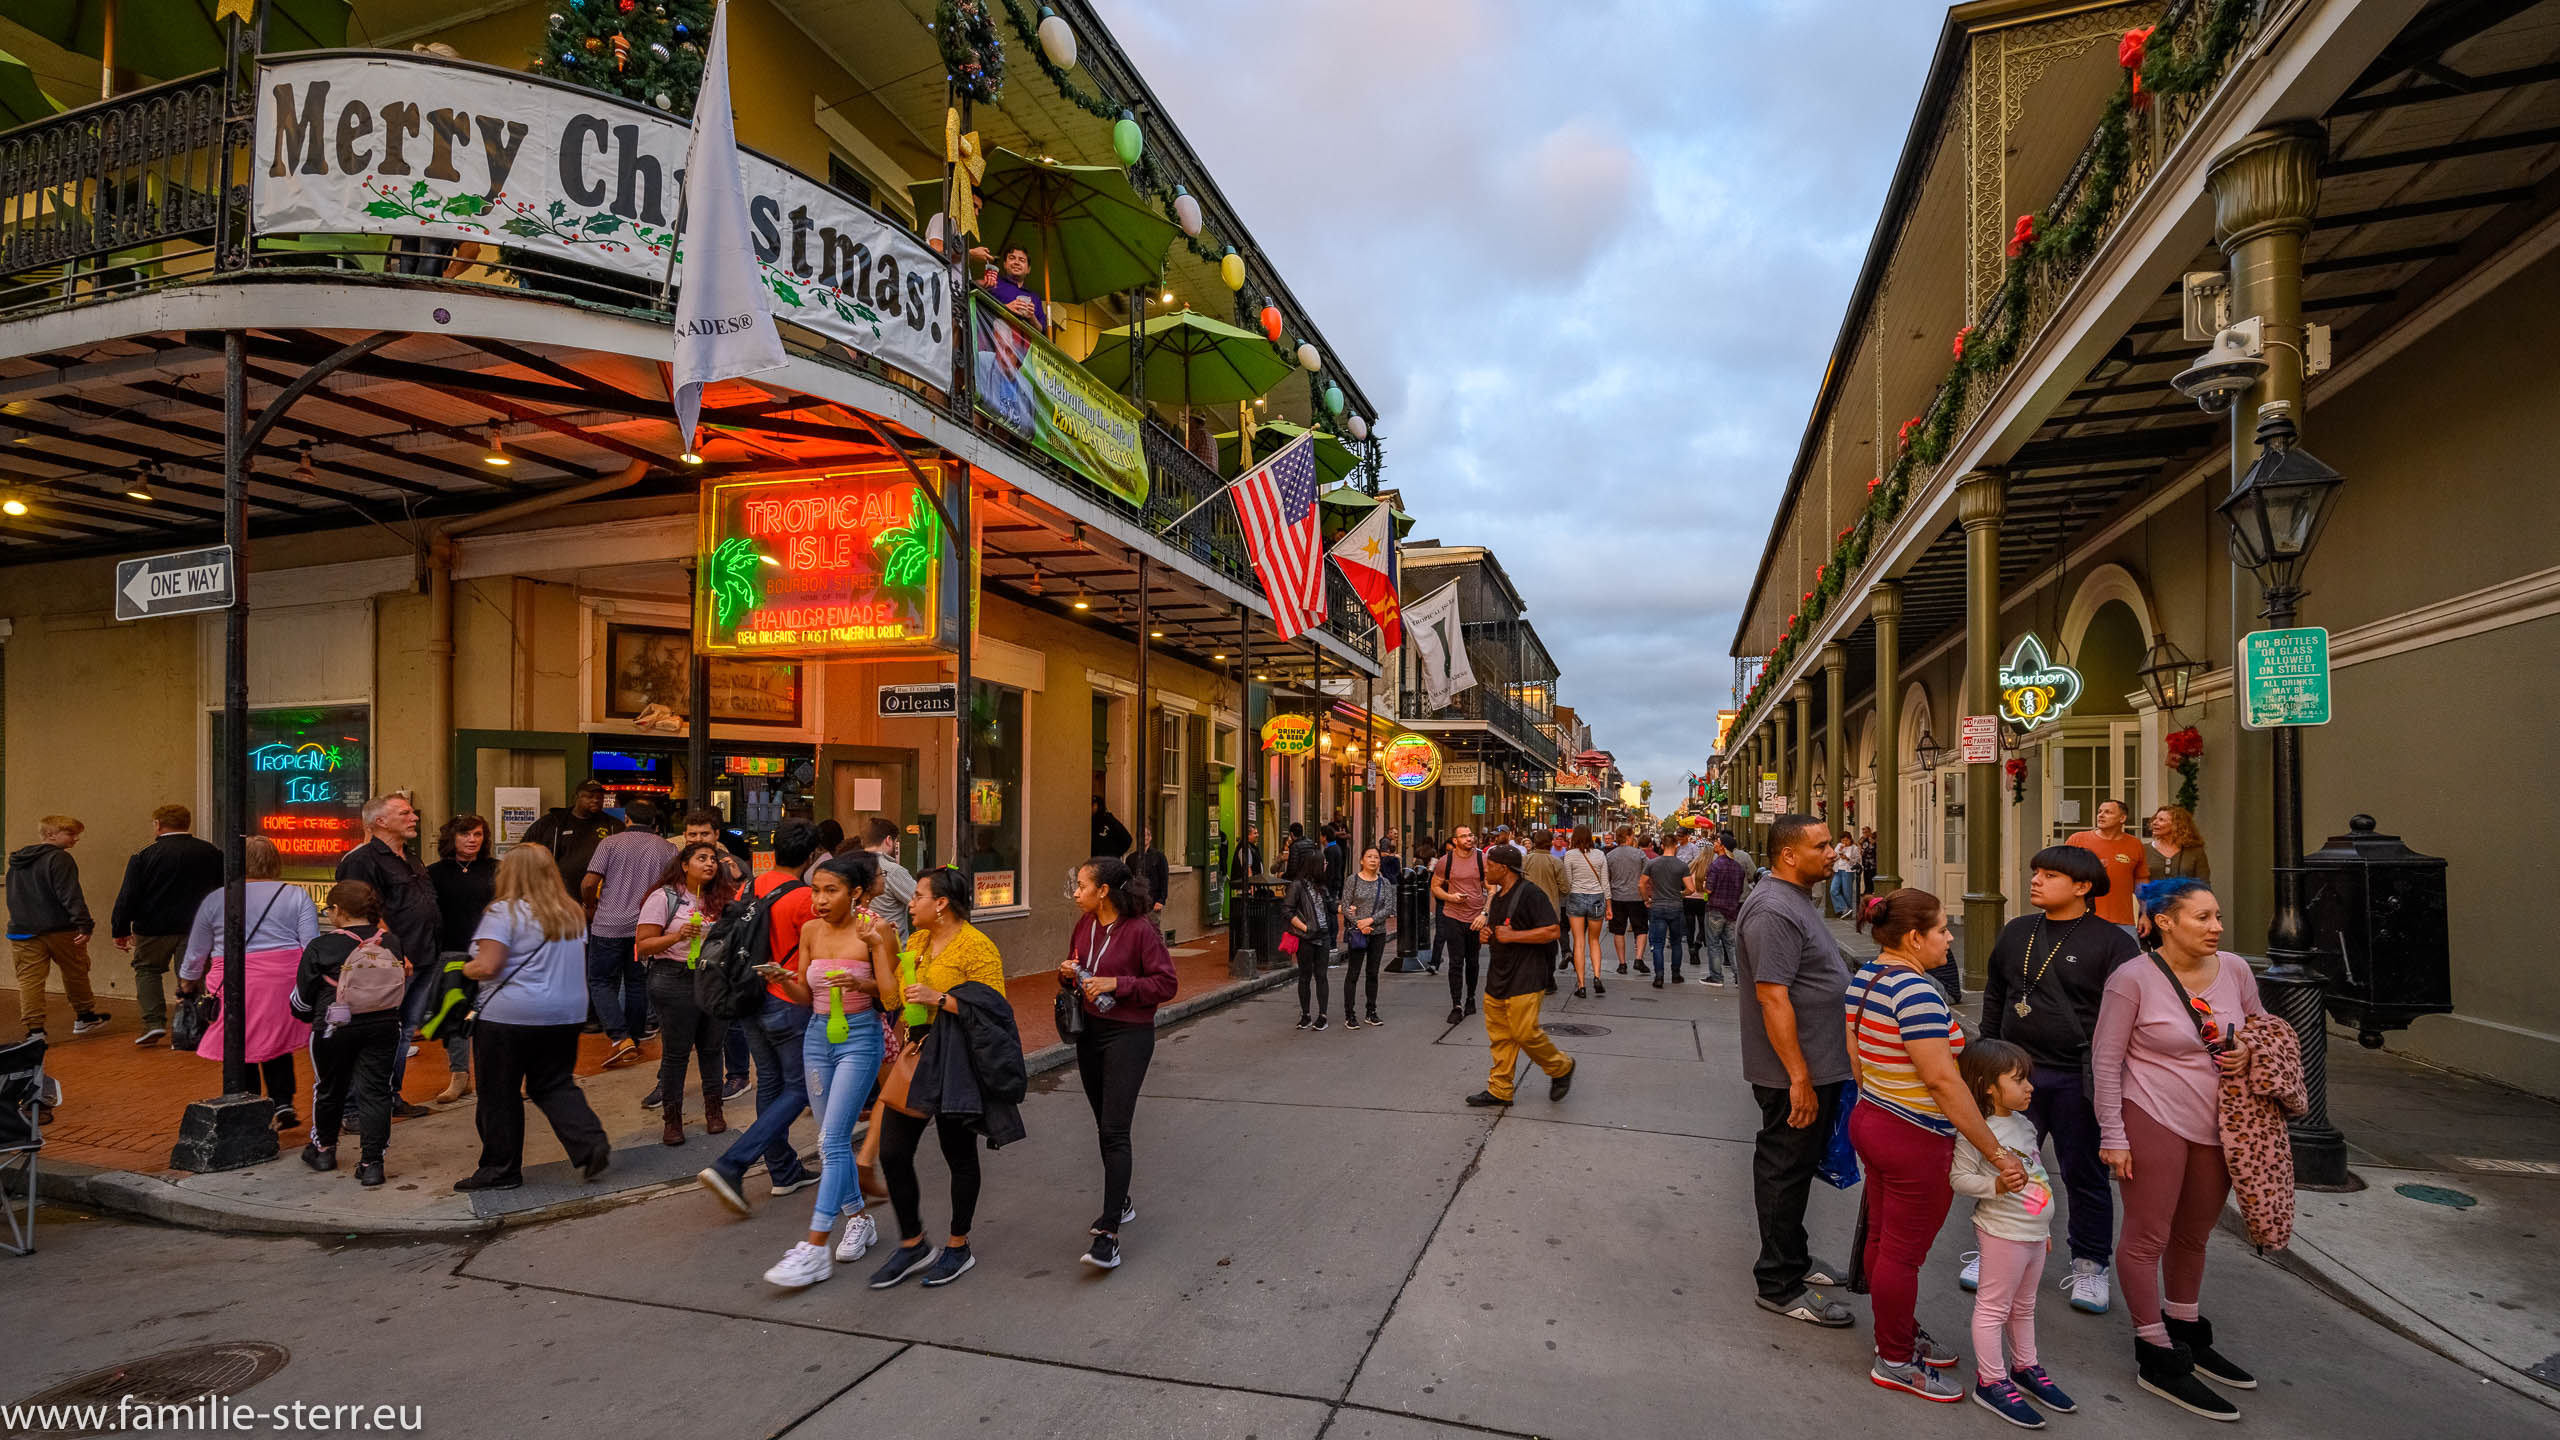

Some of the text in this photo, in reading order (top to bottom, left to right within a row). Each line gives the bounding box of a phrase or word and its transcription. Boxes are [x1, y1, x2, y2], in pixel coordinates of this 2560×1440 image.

[269, 81, 528, 216] Merry
[559, 113, 942, 344] Chstmas!
[1041, 370, 1094, 428] Celebrating
[1096, 408, 1109, 433] the
[1111, 418, 1125, 444] Life
[1127, 432, 1135, 453] of
[1053, 402, 1078, 440] Earl
[746, 491, 901, 535] TROPICAL
[789, 533, 851, 571] ISLE
[151, 566, 219, 597] ONE WAY
[767, 572, 884, 594] BOURBON STREET
[1412, 608, 1440, 626] TROPICAL
[738, 631, 756, 644] NEW
[801, 629, 828, 643] MOST
[830, 625, 876, 640] POWERFUL
[877, 624, 904, 638] DRINK
[2255, 636, 2318, 648] NO BOTTLES
[2262, 646, 2313, 657] OR GLASS
[2264, 655, 2312, 666] ALLOWED
[2000, 670, 2064, 686] Bourbon
[2259, 664, 2316, 675] ON STREET
[2263, 678, 2314, 688] ALL DRINKS
[2272, 687, 2290, 695] MAY
[886, 695, 950, 711] Orleans
[2025, 691, 2035, 715] BAR
[1275, 741, 1303, 750] TO GO
[249, 743, 325, 771] TROPICAL
[286, 776, 330, 803] ISLE
[263, 816, 296, 829] HOME
[319, 818, 339, 830] THE
[292, 838, 342, 853] GRENADE
